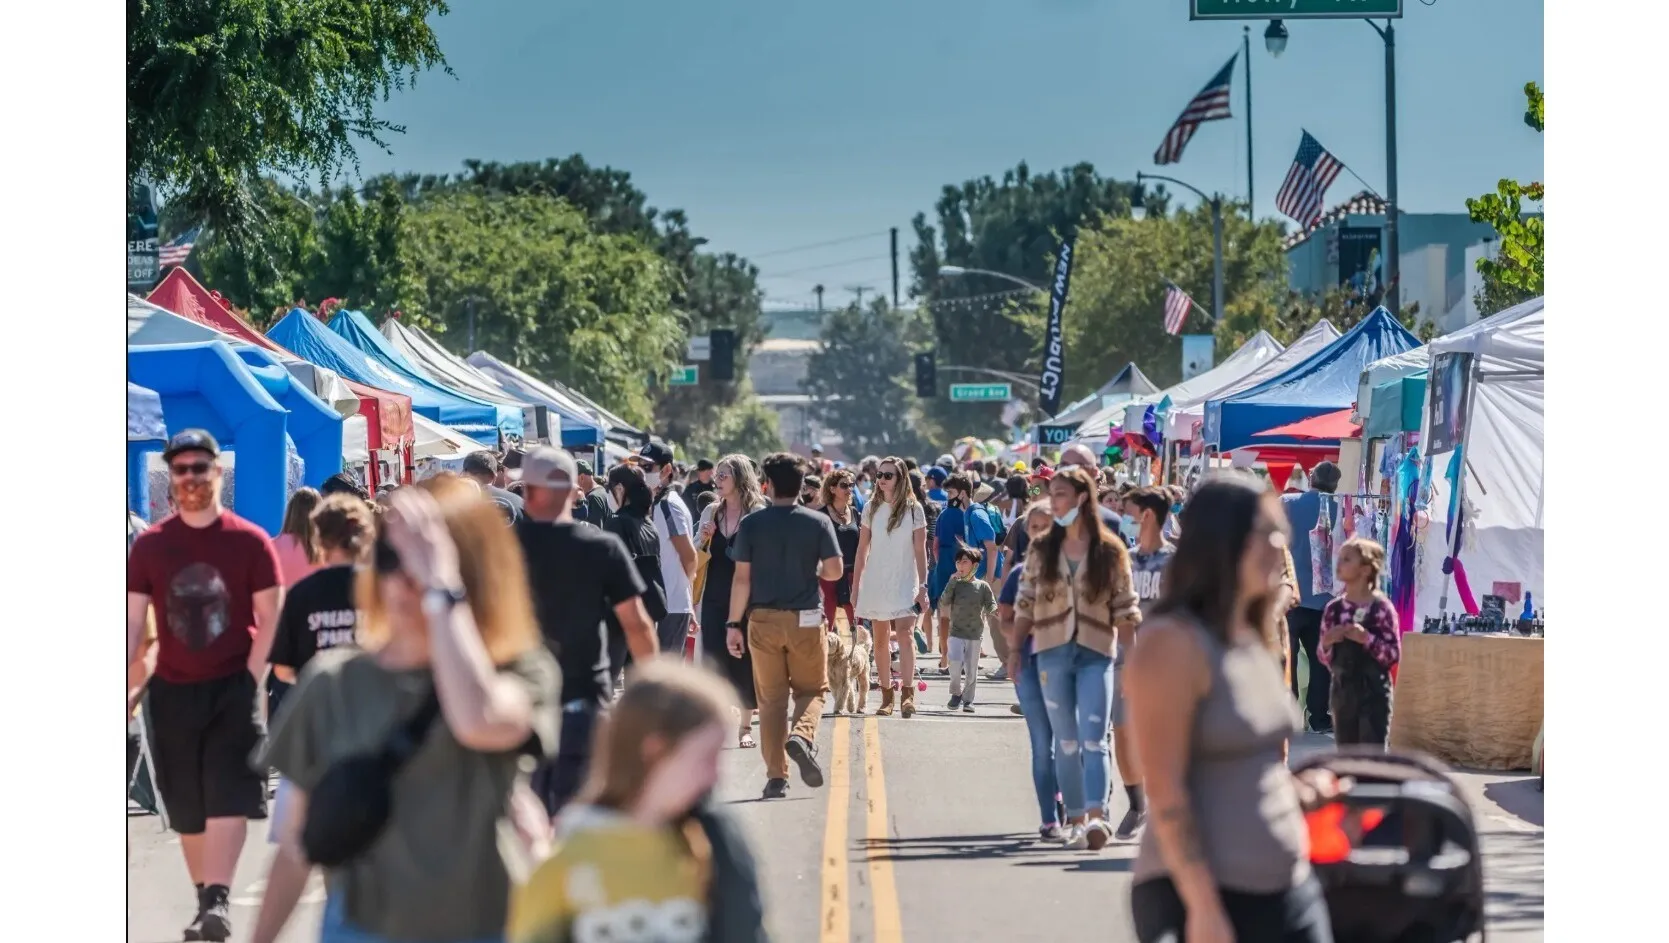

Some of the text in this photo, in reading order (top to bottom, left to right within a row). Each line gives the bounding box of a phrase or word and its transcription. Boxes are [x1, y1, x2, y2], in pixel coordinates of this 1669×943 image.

[134, 268, 154, 278] OFF
[1055, 243, 1071, 296] NEW
[957, 388, 984, 398] Grand
